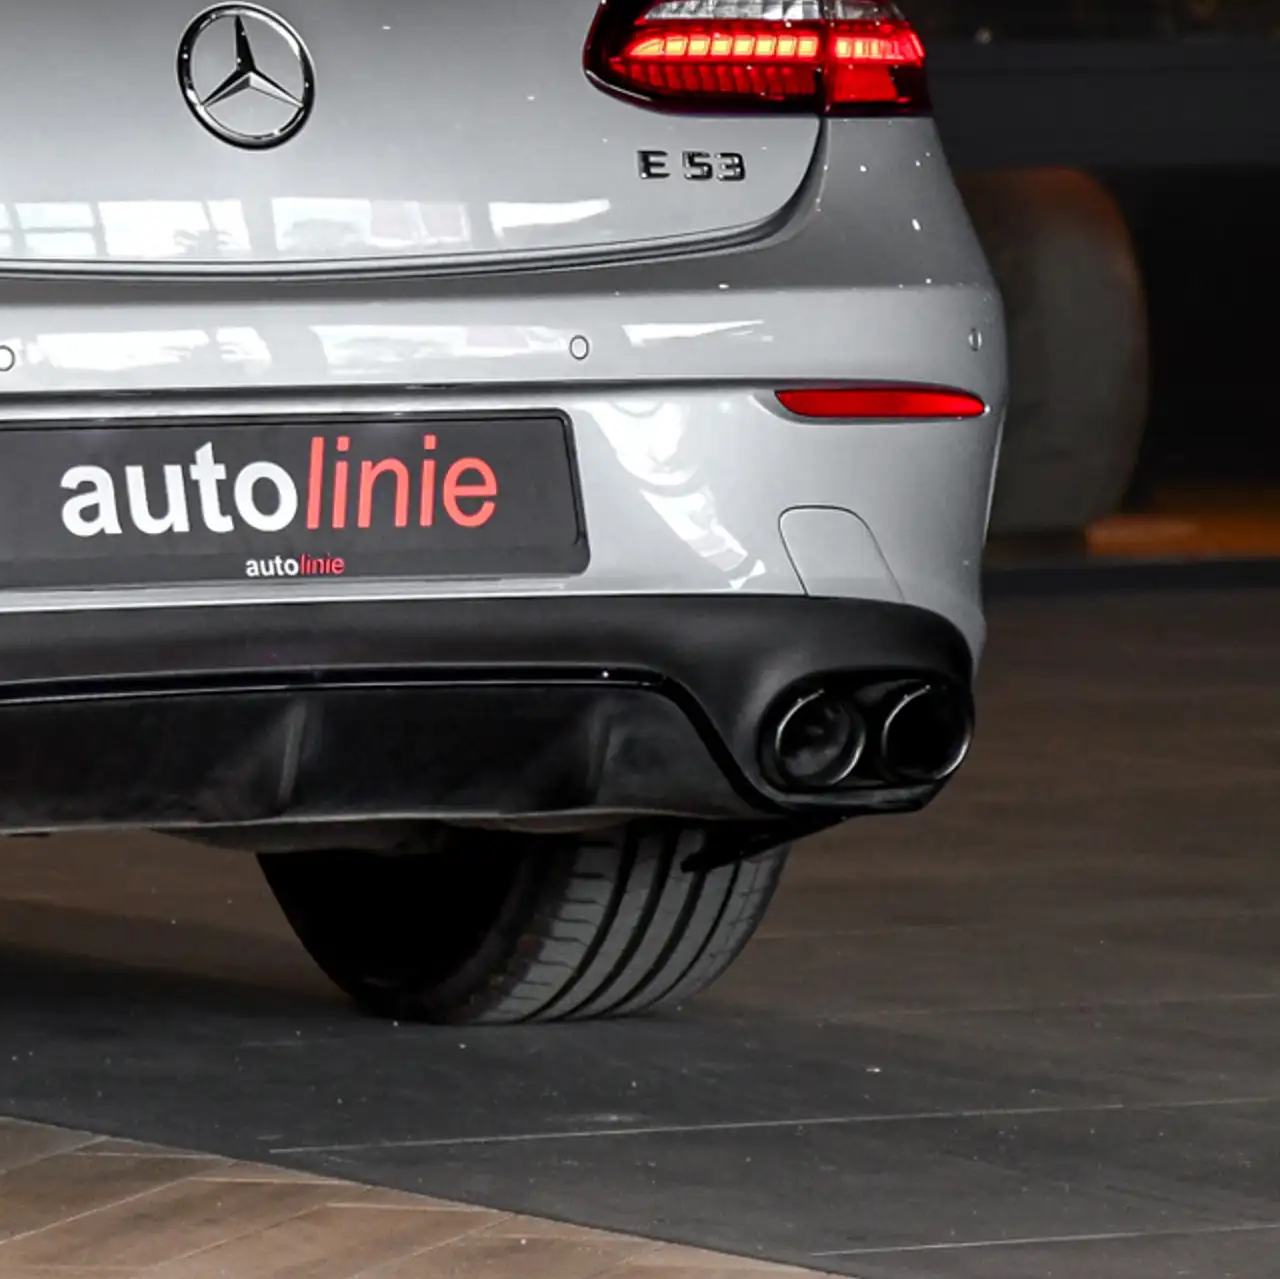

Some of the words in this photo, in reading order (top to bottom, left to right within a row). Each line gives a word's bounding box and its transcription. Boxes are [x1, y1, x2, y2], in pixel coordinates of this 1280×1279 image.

[637, 149, 671, 179] E
[681, 150, 746, 182] 53
[60, 433, 498, 537] autolinie
[244, 552, 346, 578] autolinie
